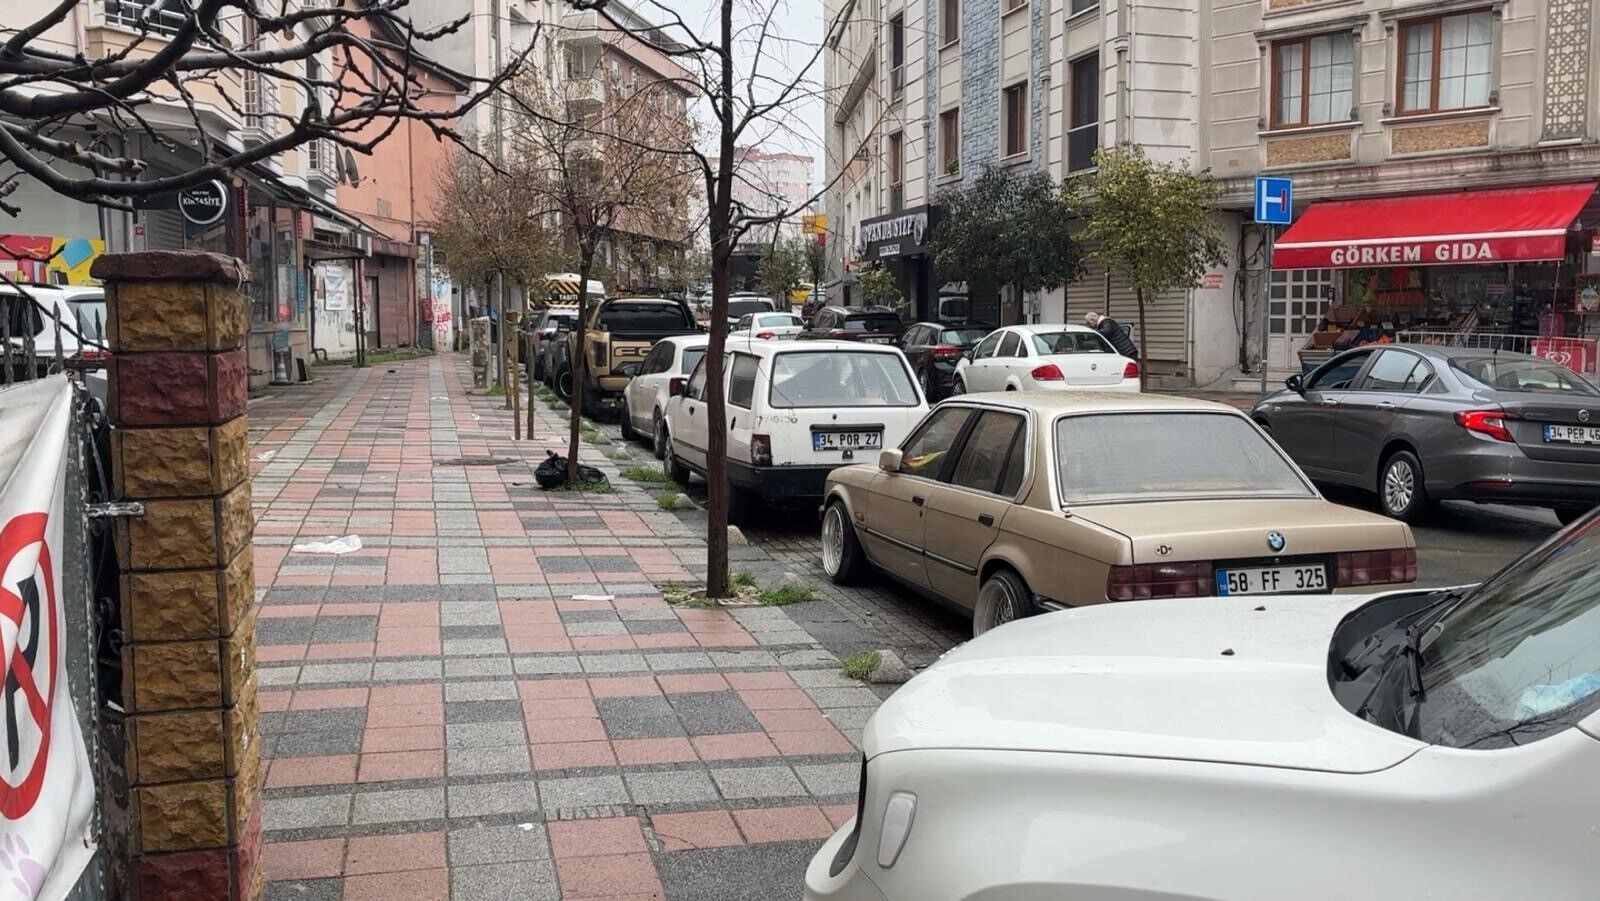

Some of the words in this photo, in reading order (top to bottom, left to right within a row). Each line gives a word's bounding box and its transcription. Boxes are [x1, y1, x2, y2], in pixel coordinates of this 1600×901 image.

[1330, 244, 1421, 265] GÖRKEM
[1435, 241, 1493, 261] GIDA
[820, 434, 833, 446] 34
[839, 433, 860, 446] POR
[865, 433, 879, 445] 27
[1550, 426, 1562, 438] 34
[1567, 427, 1585, 439] PER
[1227, 572, 1249, 592] 58
[1261, 570, 1280, 590] FF
[1294, 567, 1324, 589] 325
